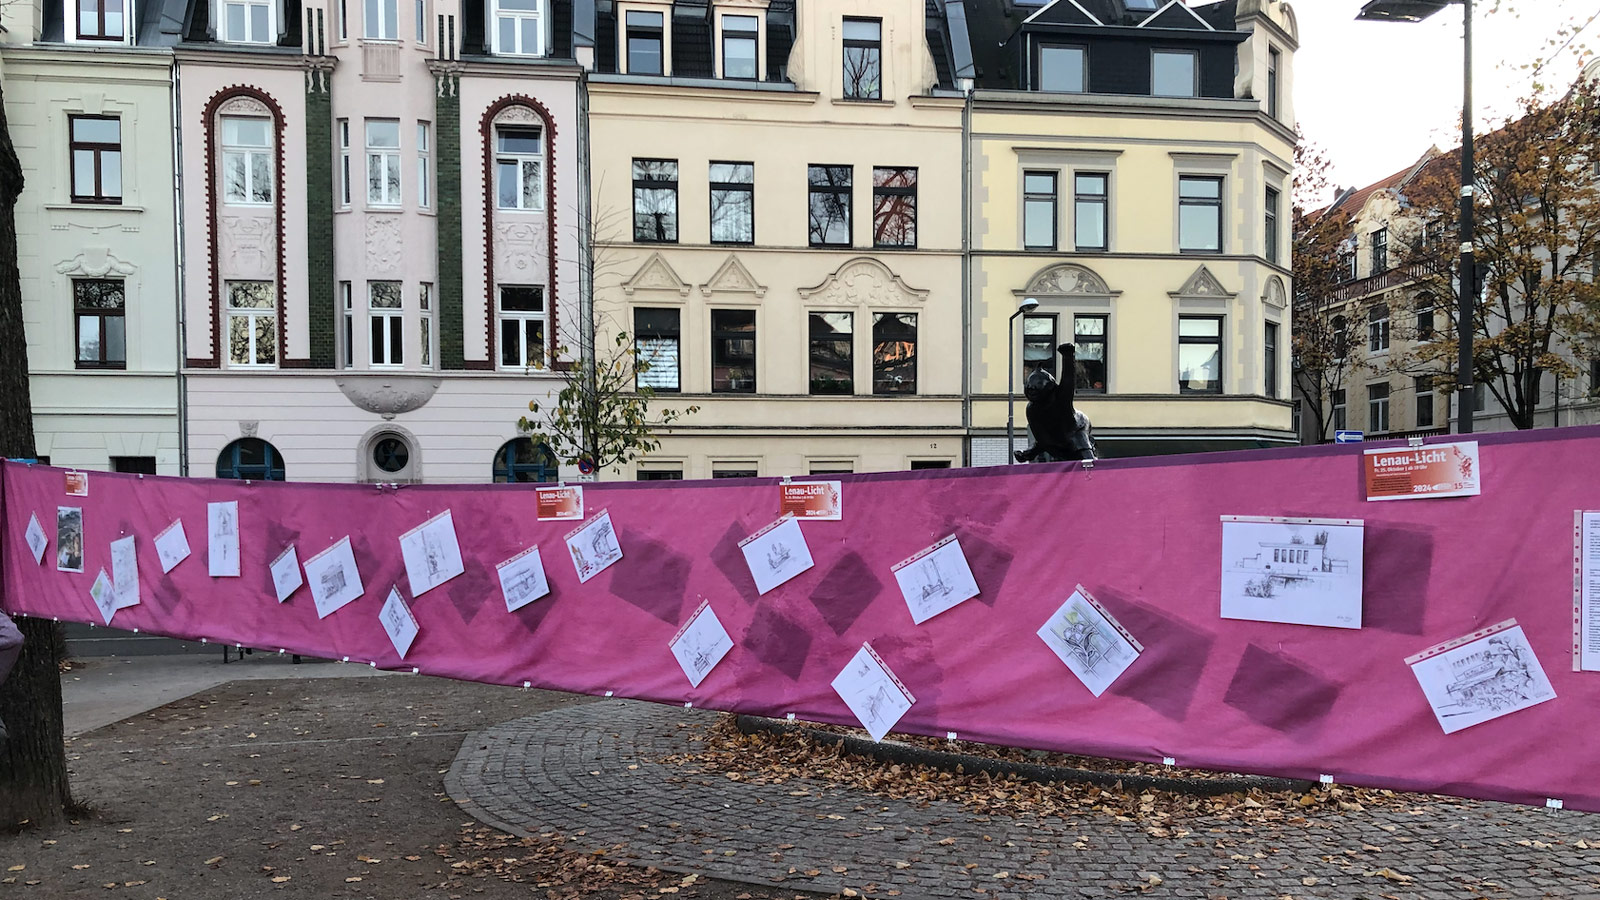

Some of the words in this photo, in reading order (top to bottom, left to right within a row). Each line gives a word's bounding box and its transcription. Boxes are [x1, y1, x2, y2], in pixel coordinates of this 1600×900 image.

[1373, 451, 1447, 467] Lenau-Licht
[784, 485, 824, 496] Lenau-Licht
[1413, 484, 1432, 493] 2024
